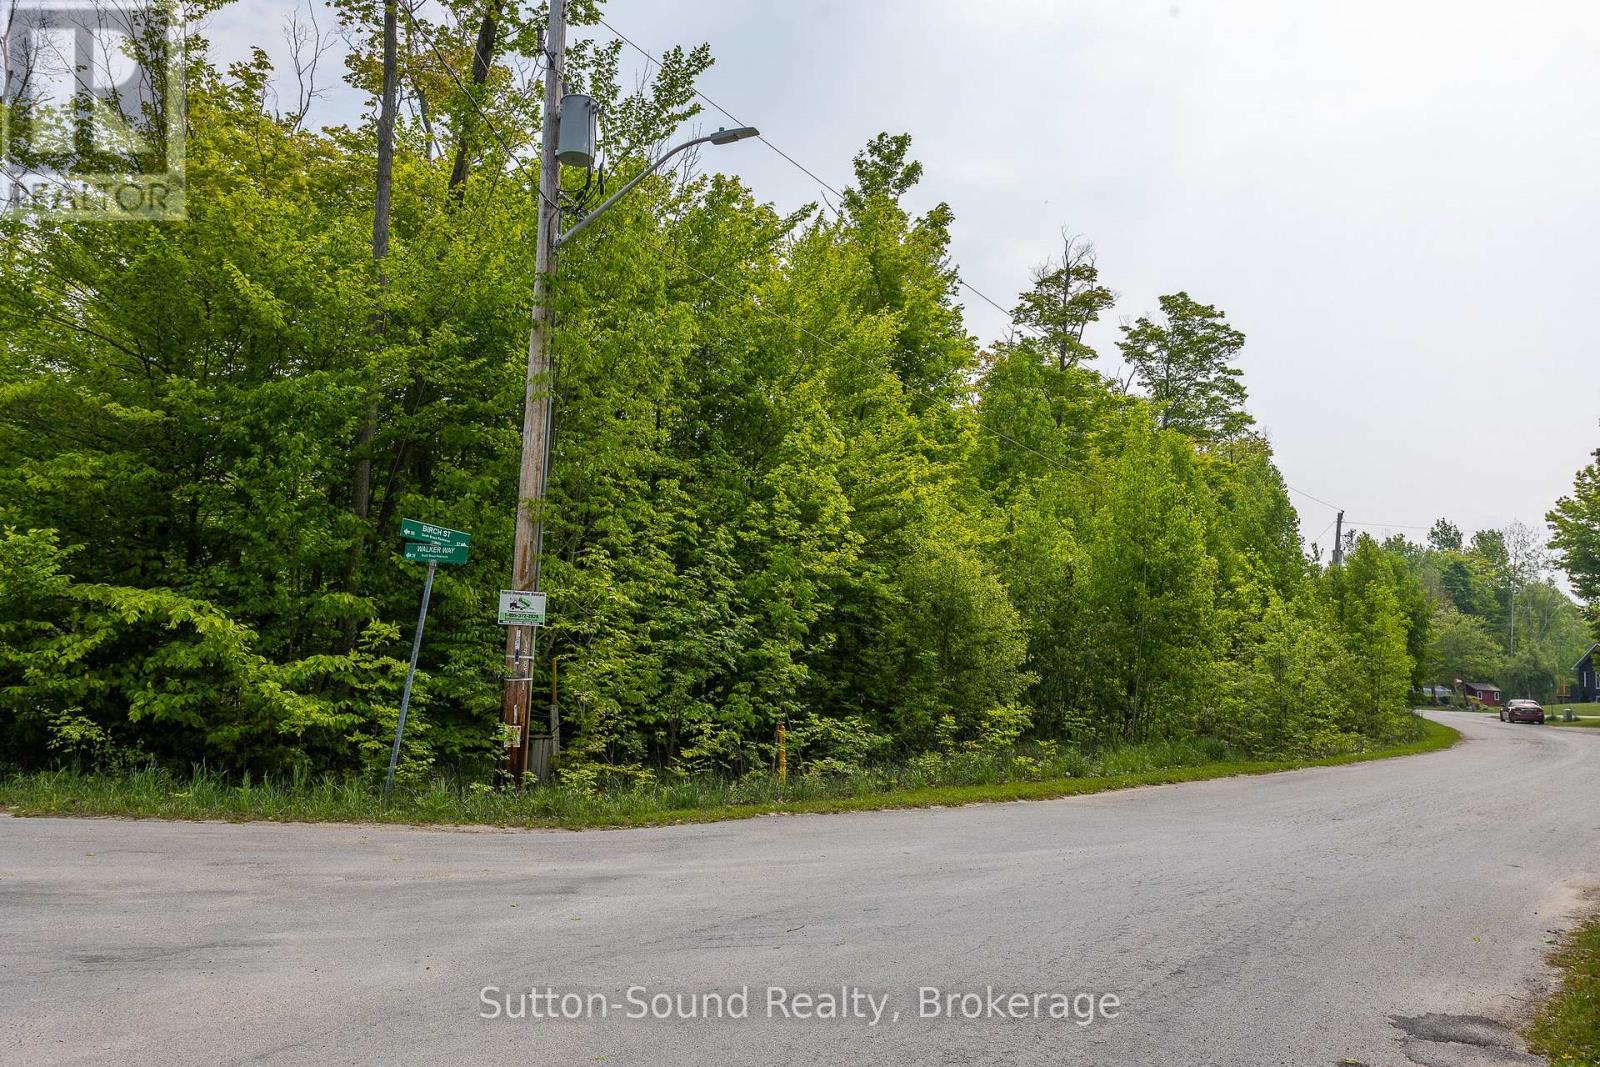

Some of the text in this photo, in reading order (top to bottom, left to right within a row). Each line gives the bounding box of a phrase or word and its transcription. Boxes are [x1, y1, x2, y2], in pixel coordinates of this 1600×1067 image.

[422, 525, 442, 536] BIRCH
[443, 530, 451, 538] ST
[417, 545, 441, 554] WALKER
